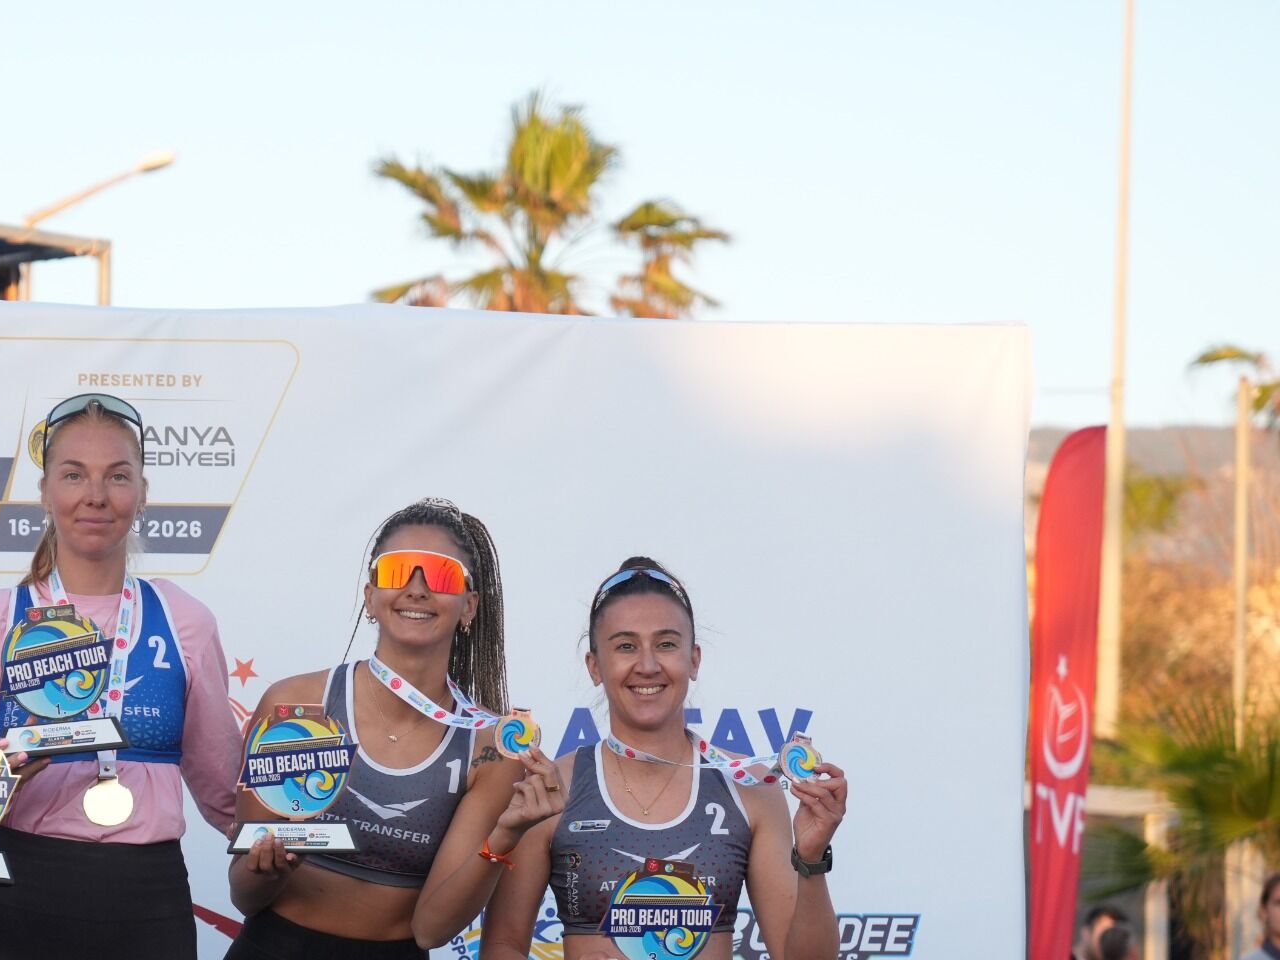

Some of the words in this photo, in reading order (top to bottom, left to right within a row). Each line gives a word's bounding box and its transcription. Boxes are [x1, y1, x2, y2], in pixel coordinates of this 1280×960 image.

[77, 373, 176, 387] PRESENTED
[181, 374, 203, 388] BY
[142, 425, 235, 447] ANYA
[142, 448, 236, 468] EDİYESİ
[147, 520, 203, 538] 2026
[148, 635, 171, 669] 2
[6, 662, 32, 684] PRO
[34, 652, 74, 678] BEACH
[74, 645, 108, 668] TOUR
[124, 706, 161, 718] SFER
[248, 757, 274, 776] PRO
[276, 751, 316, 773] BEACH
[317, 749, 350, 769] TOUR
[445, 758, 462, 794] 1
[704, 803, 729, 835] 2
[351, 818, 431, 845] TRANSFER
[610, 908, 636, 926] PRO
[638, 908, 678, 926] BEACH
[681, 909, 712, 926] TOUR
